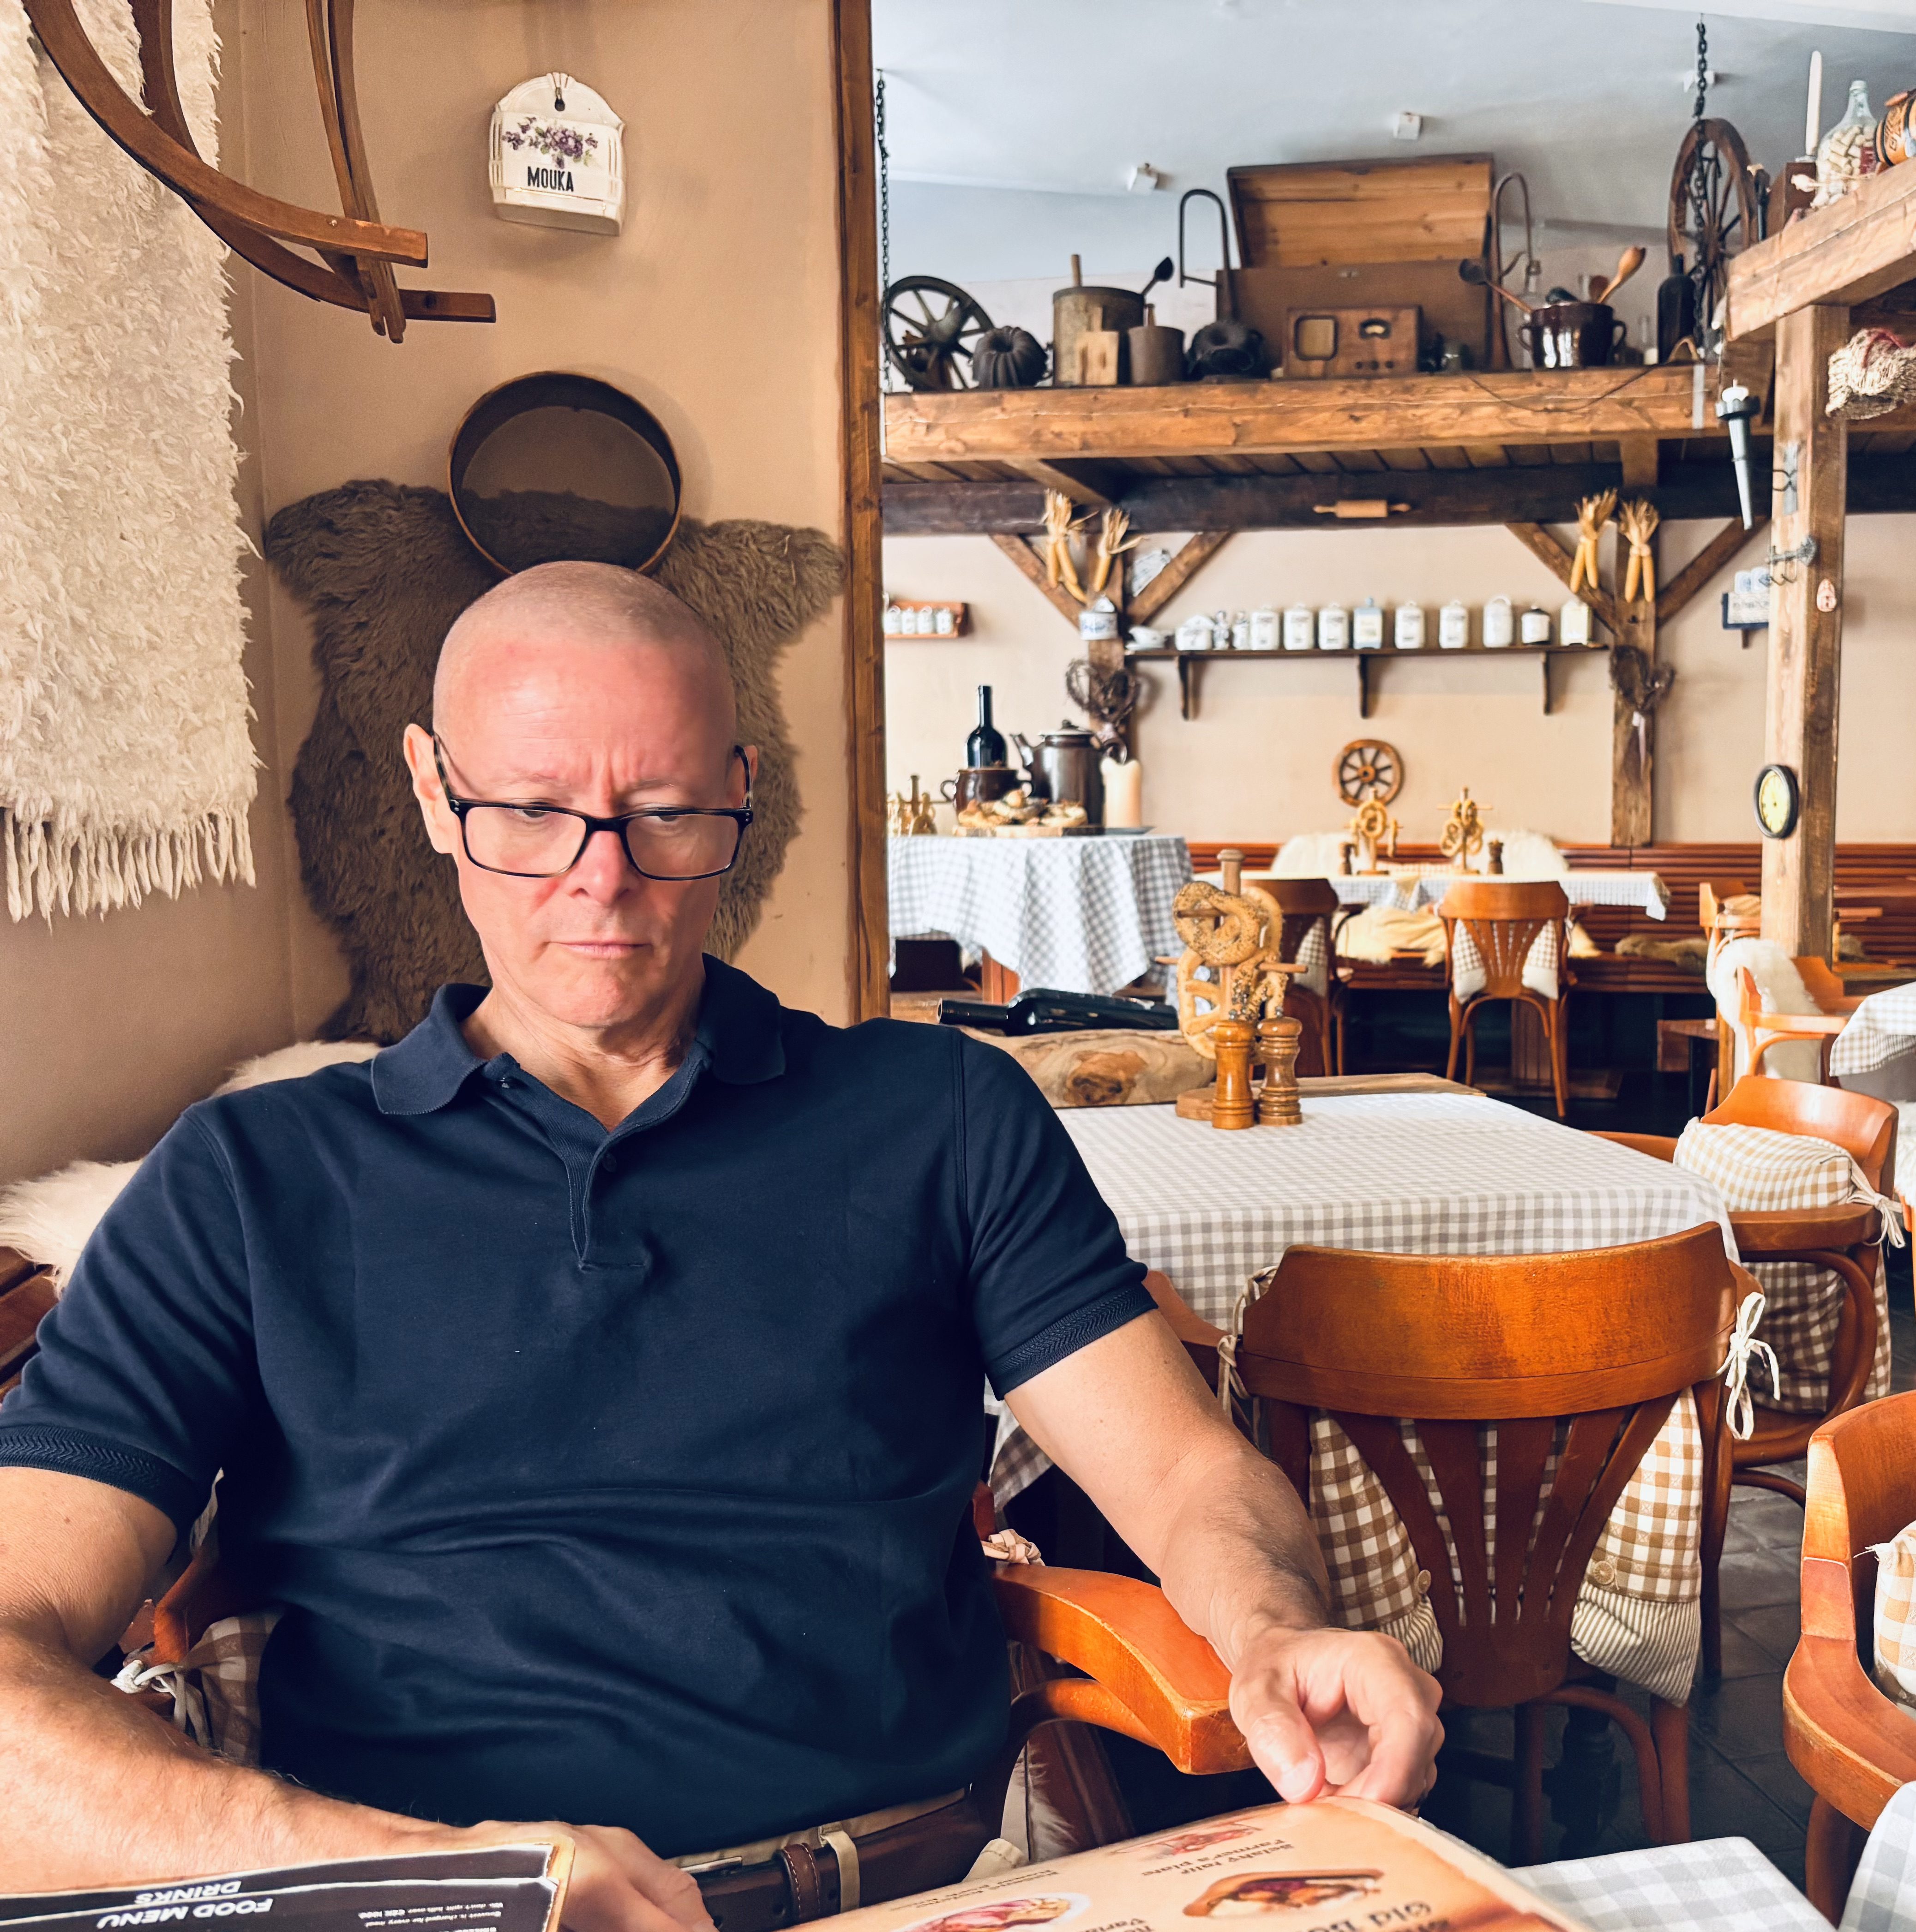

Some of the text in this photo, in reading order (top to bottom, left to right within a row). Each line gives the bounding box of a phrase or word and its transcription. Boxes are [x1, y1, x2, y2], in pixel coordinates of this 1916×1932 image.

[527, 166, 575, 192] MOUKA
[134, 1881, 241, 1905] DRINKS
[96, 1898, 273, 1929] FOOD MENU
